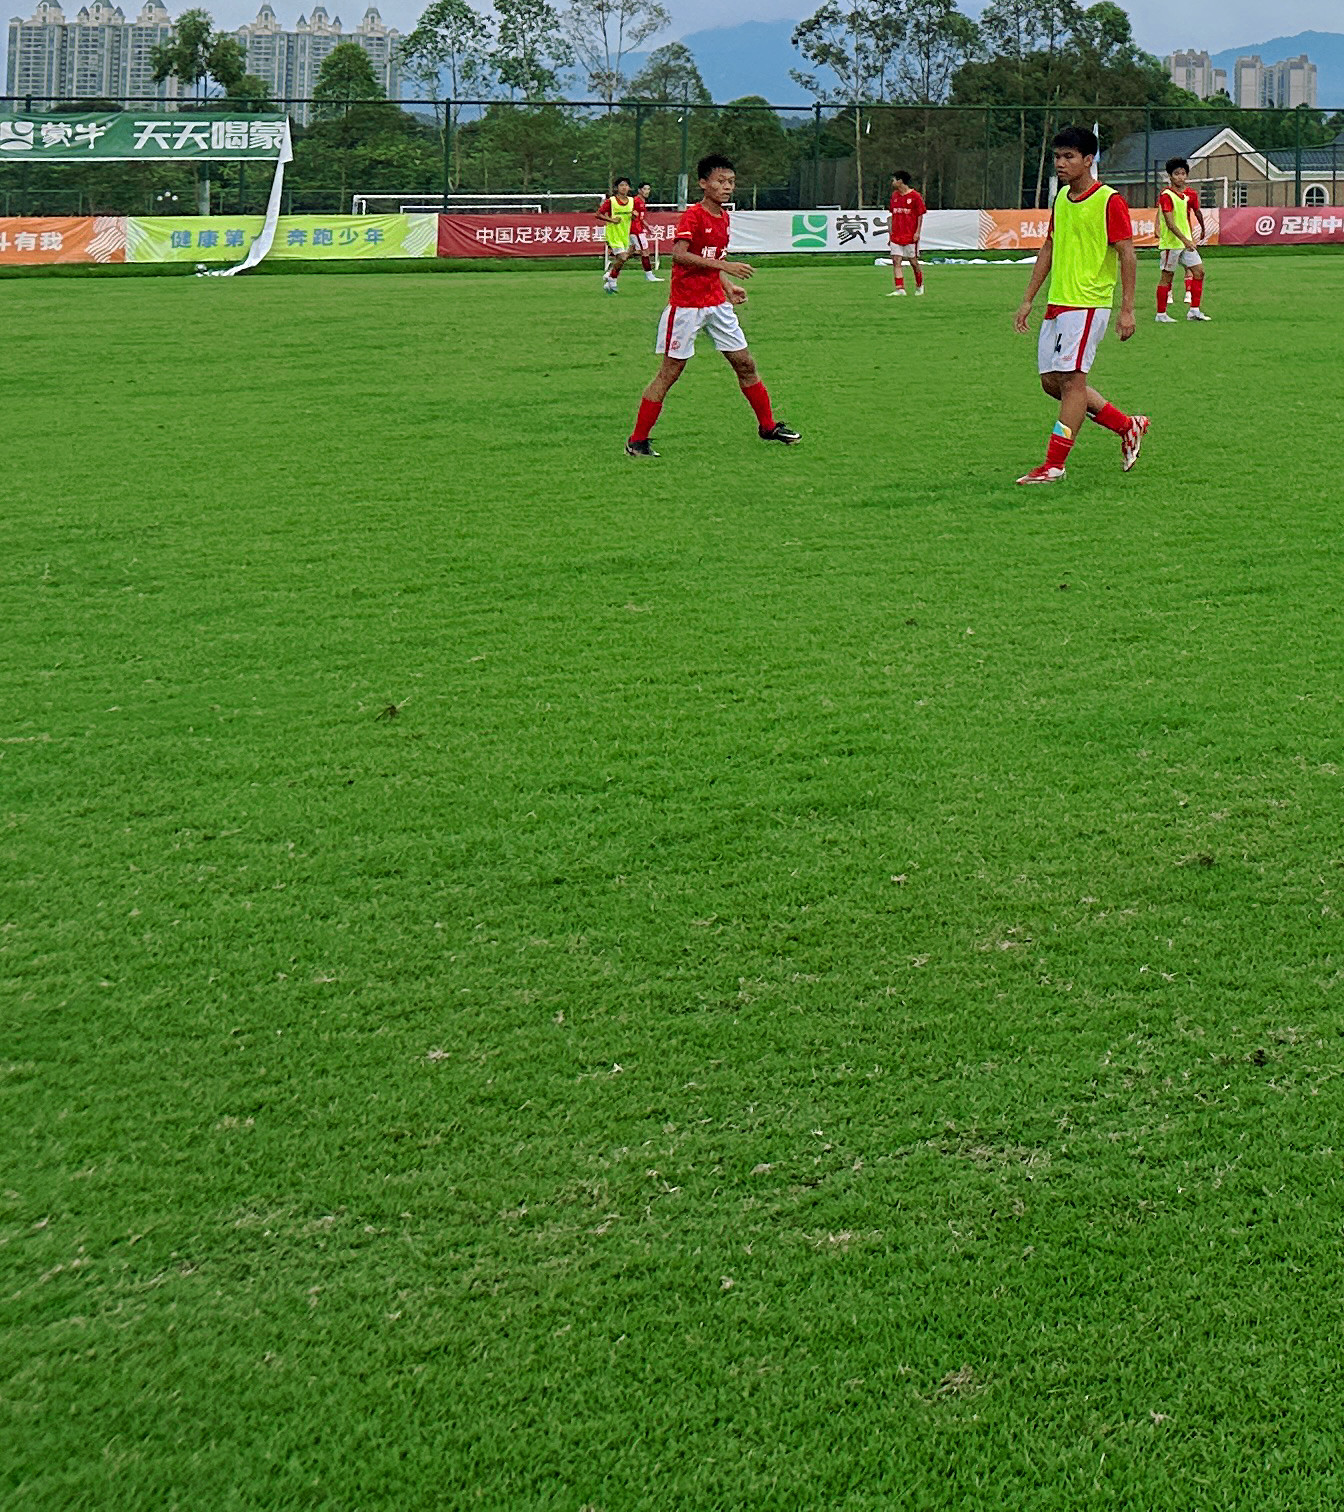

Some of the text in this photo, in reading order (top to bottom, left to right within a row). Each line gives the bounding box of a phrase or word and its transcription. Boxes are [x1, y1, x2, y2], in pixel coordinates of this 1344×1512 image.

[41, 122, 105, 149] 蒙牛
[287, 228, 385, 245] 奔跑少年
